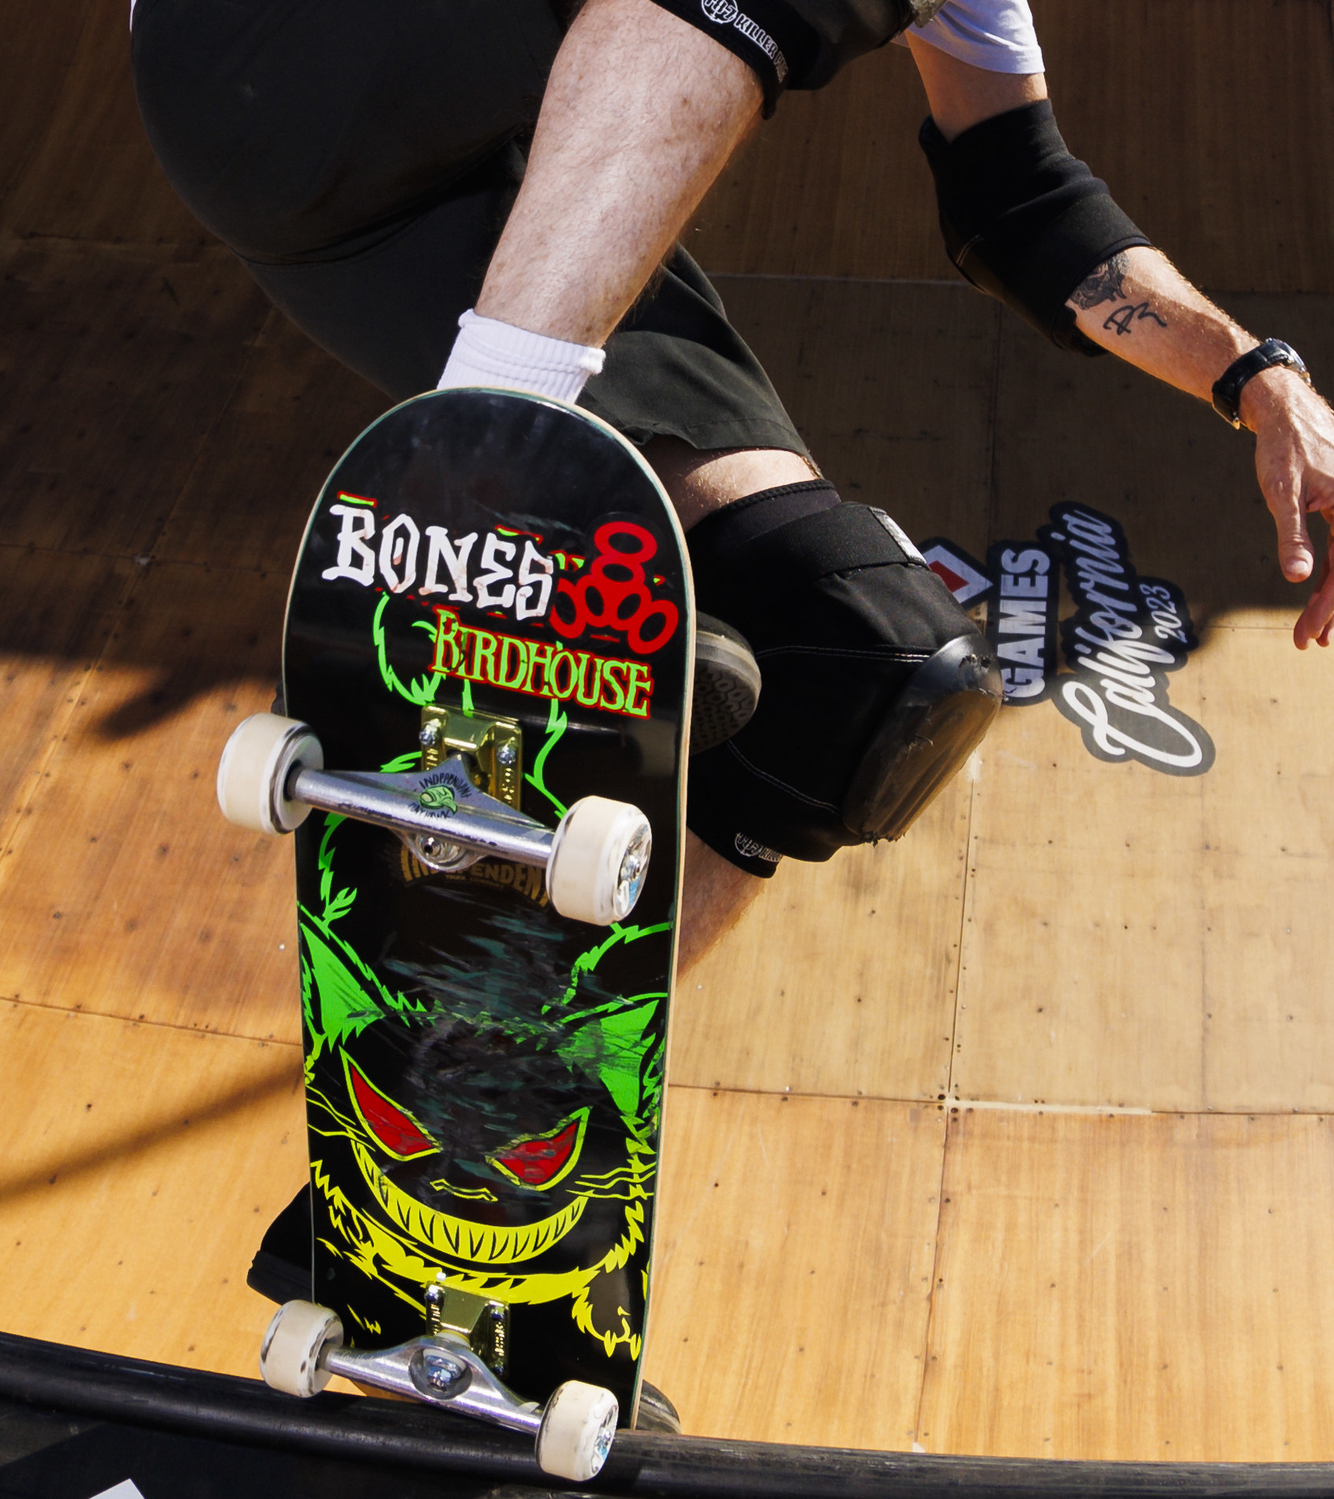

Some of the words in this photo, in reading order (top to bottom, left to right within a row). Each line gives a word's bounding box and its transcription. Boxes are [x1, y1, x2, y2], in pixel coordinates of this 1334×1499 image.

[733, 13, 778, 60] KILLER
[321, 503, 554, 621] BONES
[1139, 583, 1188, 644] 2023
[429, 604, 653, 720] BIRDHOUSE
[997, 548, 1051, 699] GAMES
[1062, 509, 1203, 768] California
